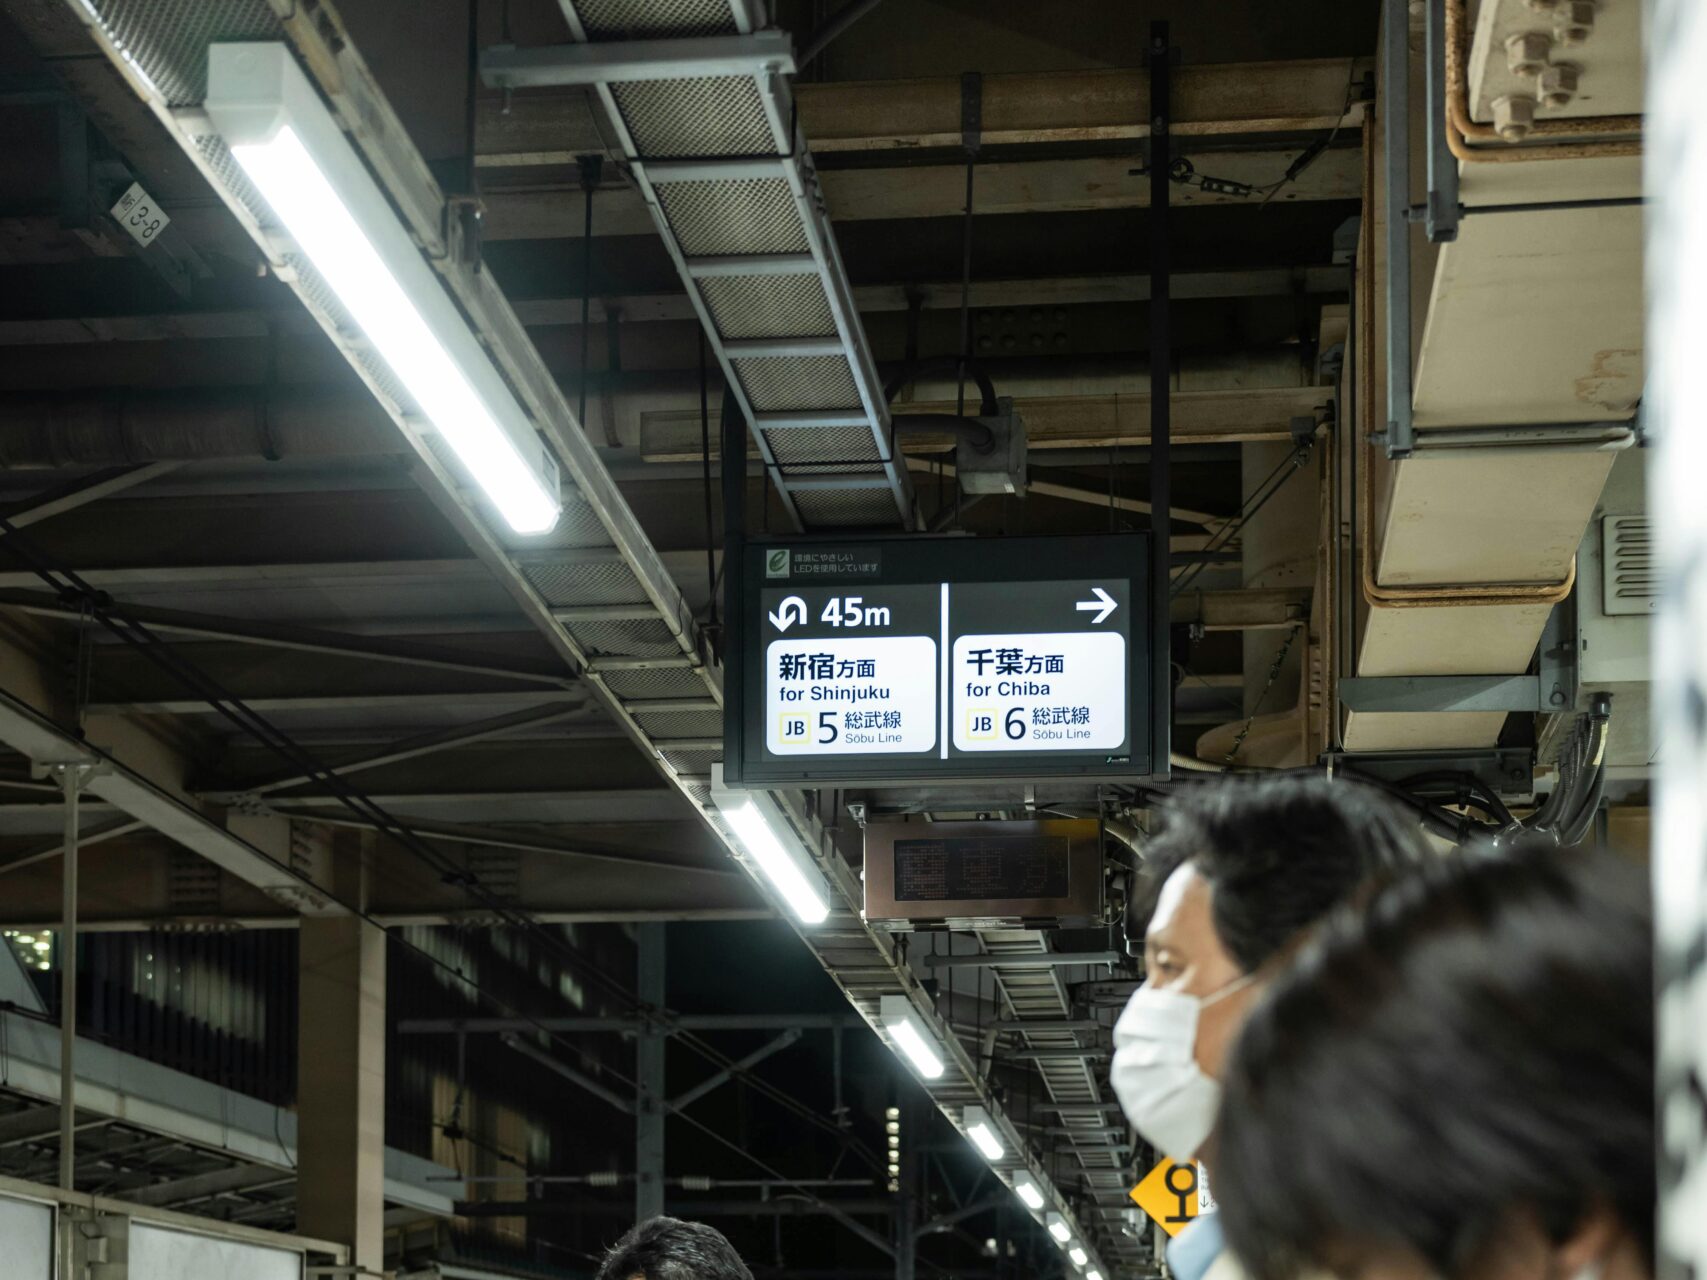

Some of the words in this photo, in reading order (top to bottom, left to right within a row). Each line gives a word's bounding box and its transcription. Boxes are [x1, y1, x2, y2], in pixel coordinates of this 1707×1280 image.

[130, 206, 160, 238] 3-8
[794, 553, 854, 563] 環境にやさしい
[794, 563, 879, 574] LEDを使用しています
[821, 597, 891, 627] 45m
[779, 653, 876, 681] 新宿方面
[966, 648, 1065, 676] 千葉方面
[780, 687, 805, 702] for
[810, 685, 891, 704] Shinjuku
[967, 682, 992, 697] for
[997, 681, 1051, 697] Chiba
[844, 710, 902, 730] 総武線
[972, 716, 992, 732] JB
[1005, 707, 1026, 740] 6
[1032, 706, 1091, 726] 総武線
[785, 720, 805, 736] JB
[818, 711, 839, 744] 5
[1066, 727, 1091, 740] Line
[878, 732, 903, 744] Line
